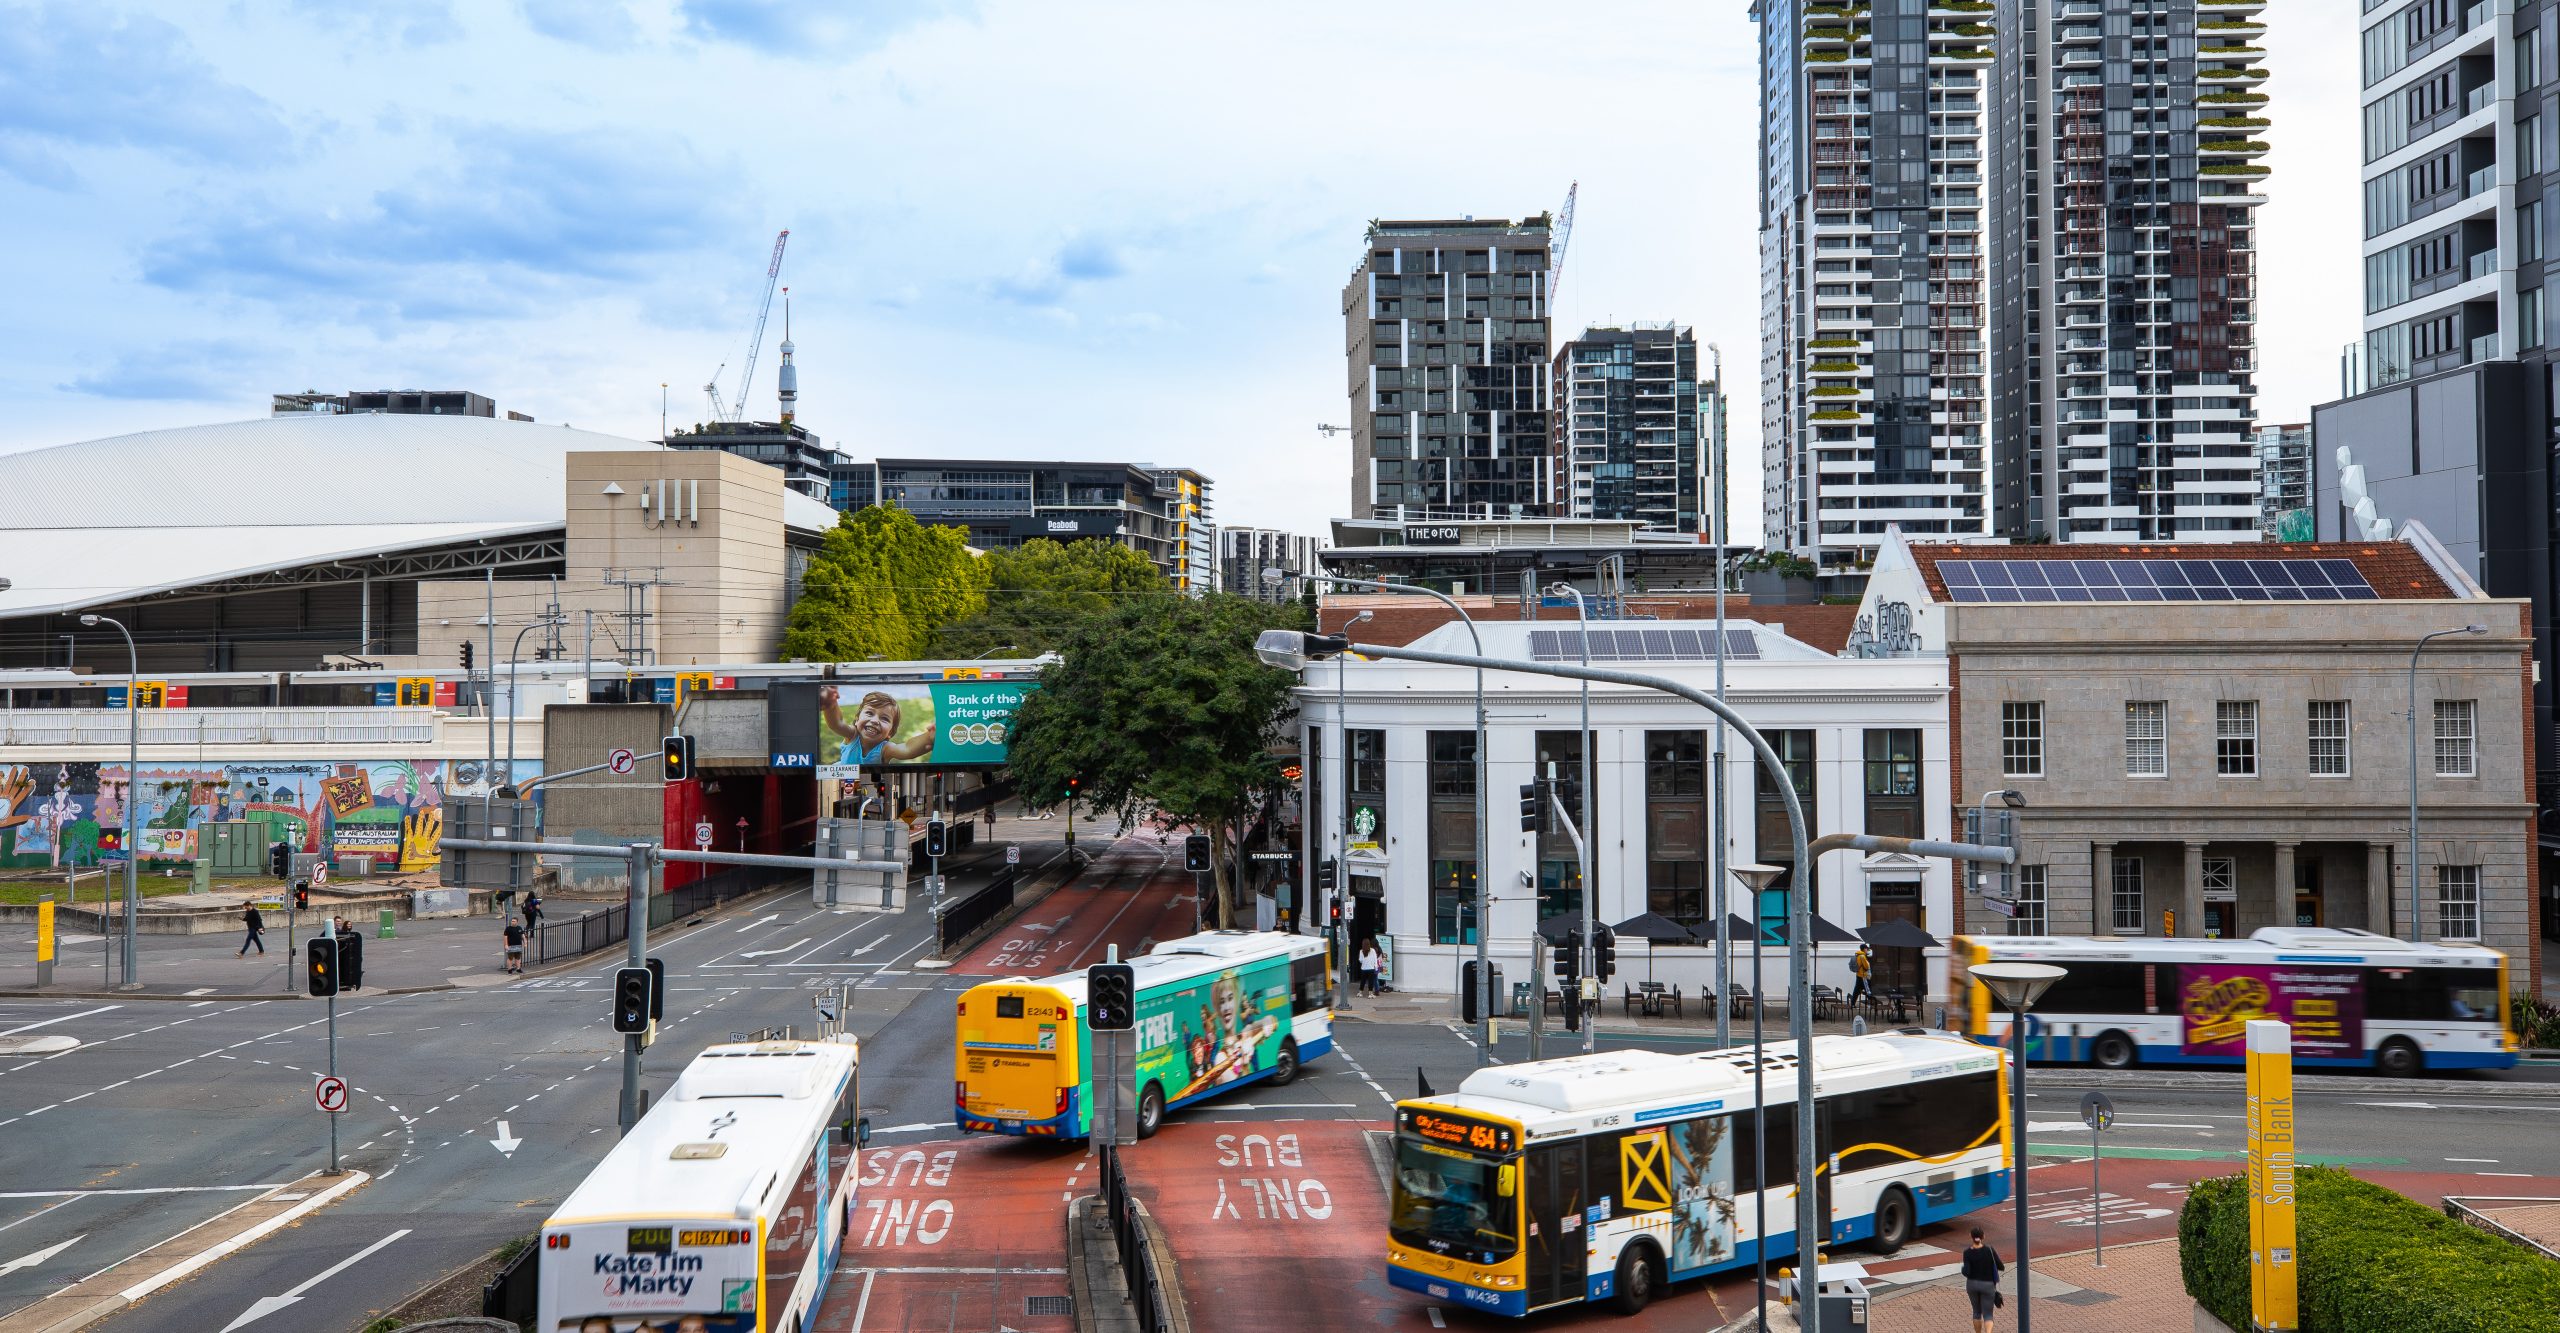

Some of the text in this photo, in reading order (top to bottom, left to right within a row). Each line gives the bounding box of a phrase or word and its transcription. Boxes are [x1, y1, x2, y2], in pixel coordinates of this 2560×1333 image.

[1048, 520, 1078, 531] Peabody
[1409, 528, 1459, 539] THE FOX
[948, 694, 980, 705] Bank
[981, 693, 995, 704] of
[997, 693, 1017, 704] the
[948, 708, 980, 718] after
[775, 754, 810, 766] APN
[699, 829, 709, 838] 40
[1002, 939, 1073, 953] ONLY
[986, 953, 1046, 968] BUS
[1027, 1007, 1054, 1016] E2143
[1099, 1009, 1108, 1018] B
[1416, 1115, 1434, 1129] City
[1469, 1125, 1496, 1150] 454
[1215, 1134, 1303, 1168] BUS
[2247, 1093, 2262, 1202] South Bank
[2262, 1096, 2294, 1205] South Bank
[858, 1150, 958, 1188] BUS
[1211, 1178, 1334, 1220] ONLY
[861, 1199, 955, 1248] ONL
[655, 1252, 703, 1274] Tim
[619, 1274, 695, 1297] Marty
[1465, 1287, 1500, 1305] W1436
